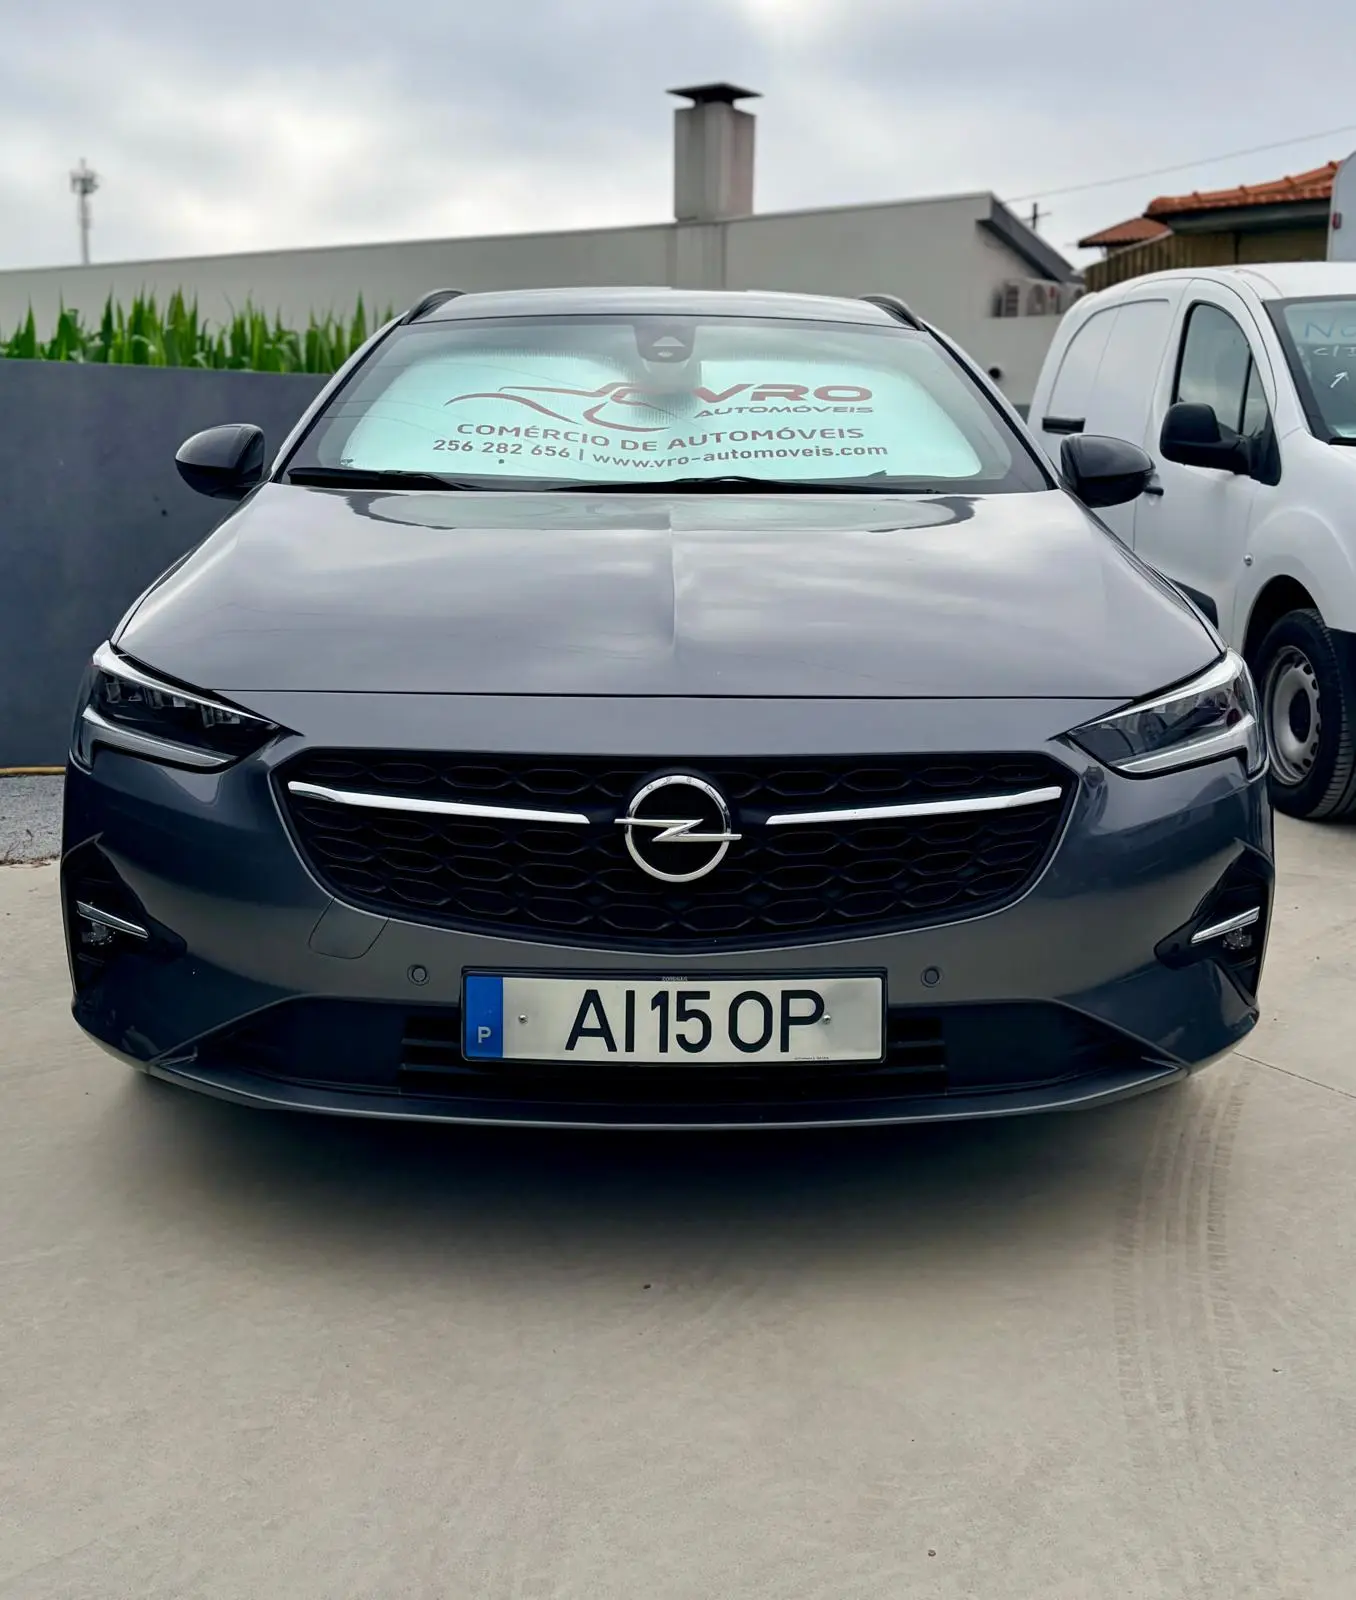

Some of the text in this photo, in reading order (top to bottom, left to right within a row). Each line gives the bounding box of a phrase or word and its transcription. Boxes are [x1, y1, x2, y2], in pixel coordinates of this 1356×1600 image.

[691, 383, 873, 404] VRO
[693, 405, 874, 419] AUTOMÓVEIS
[457, 423, 864, 451] COMÉRCIO DE AUTOMÓVEIS
[432, 439, 473, 452] 256
[481, 441, 522, 455] 282
[530, 444, 570, 458] 656
[592, 445, 888, 468] www.vro-automoveis.com
[477, 1026, 492, 1044] P
